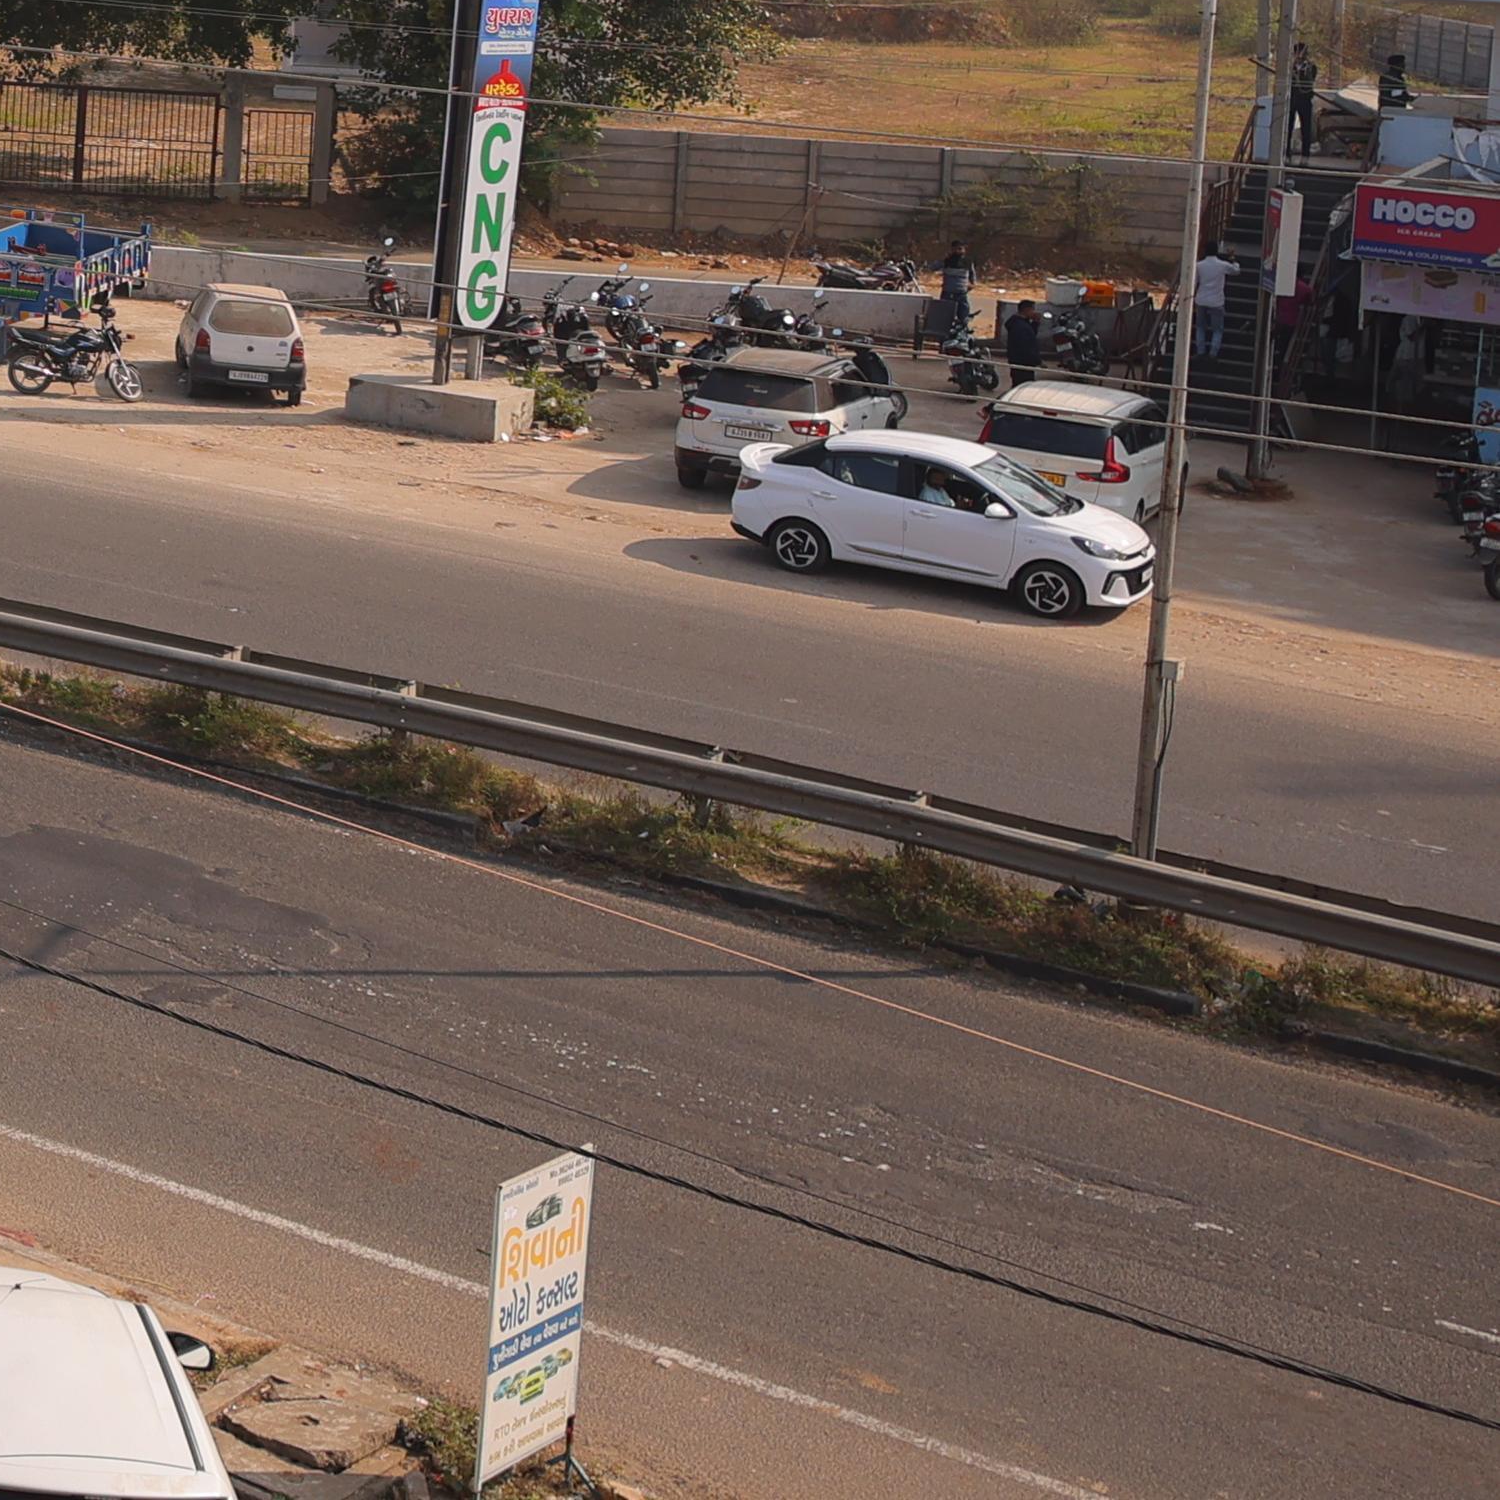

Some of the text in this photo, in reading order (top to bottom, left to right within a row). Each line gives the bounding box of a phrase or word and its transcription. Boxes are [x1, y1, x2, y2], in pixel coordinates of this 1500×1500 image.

[486, 8, 534, 33] યુવરાજ
[467, 122, 513, 322] CNG
[1372, 198, 1475, 230] HOCCO
[1397, 228, 1442, 238] ICE CREAM
[1415, 251, 1439, 260] COLD
[1440, 254, 1472, 264] DRINKS
[499, 1196, 585, 1289] શિવાની
[499, 1283, 529, 1332] ઓટો
[494, 1423, 510, 1441] RTO
